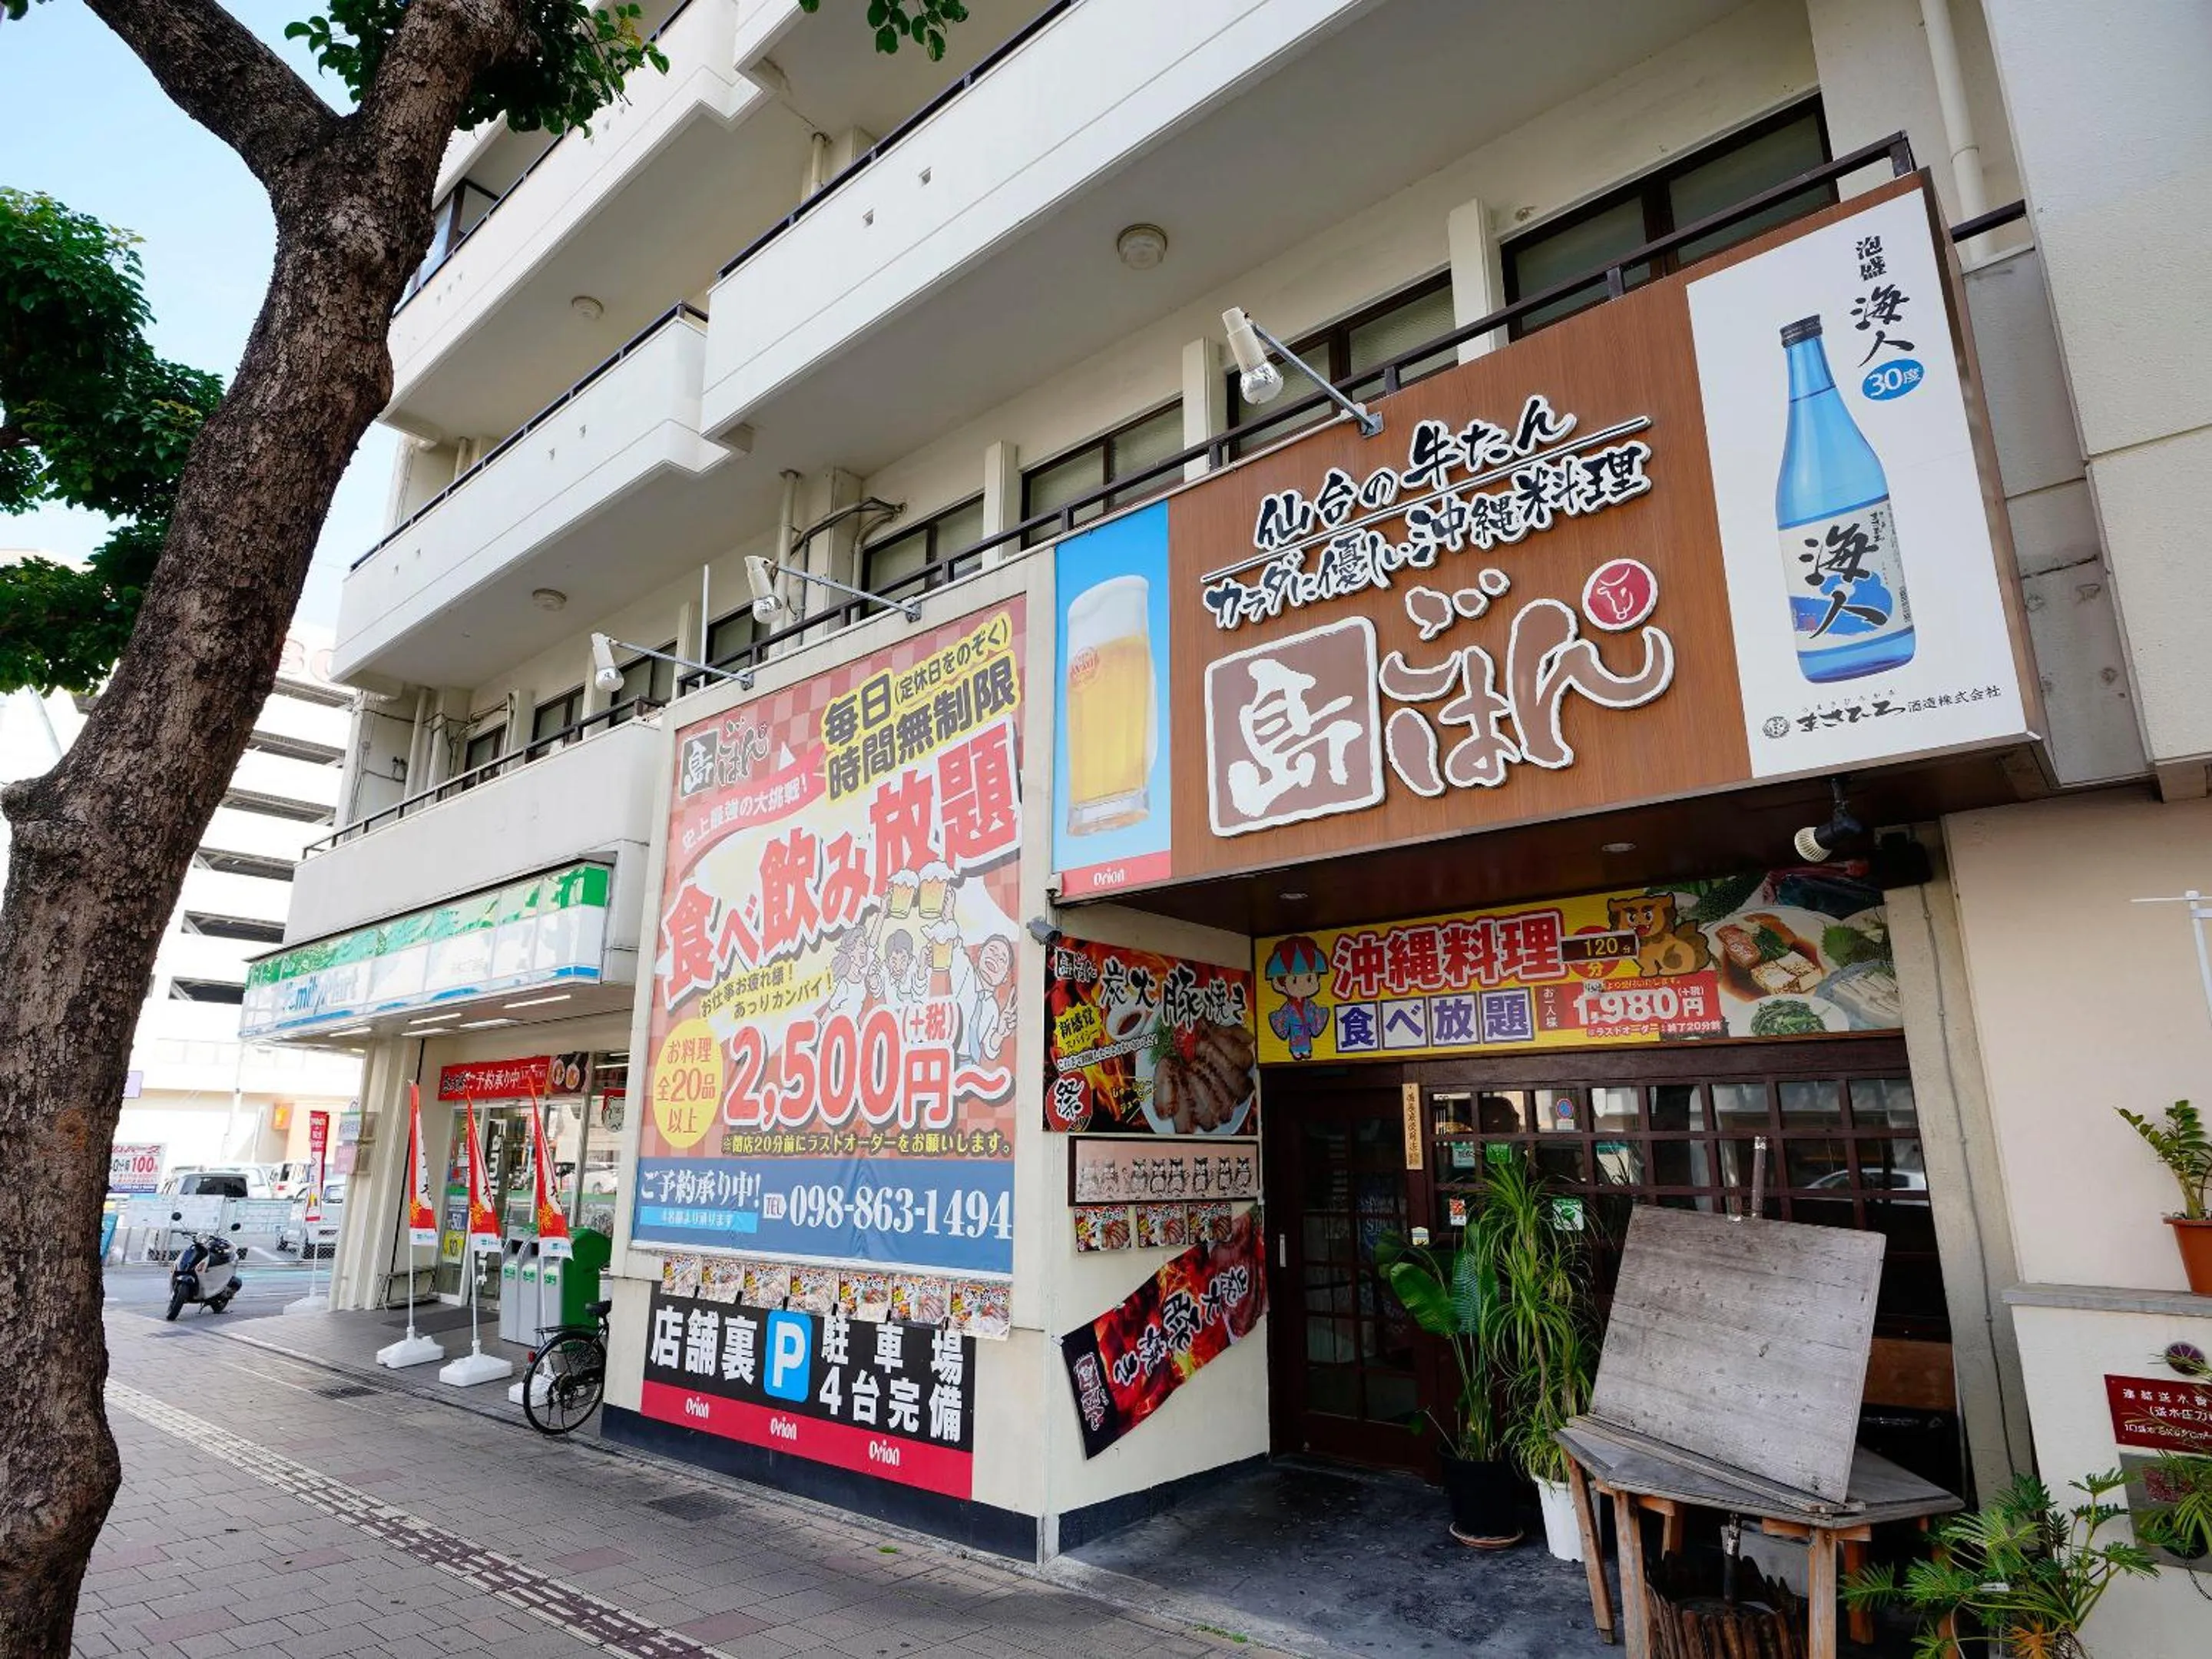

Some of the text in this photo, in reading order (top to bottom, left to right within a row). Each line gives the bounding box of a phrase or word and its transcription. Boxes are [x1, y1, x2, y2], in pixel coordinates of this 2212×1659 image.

[1849, 283, 1916, 369] 海人
[1867, 367, 1922, 396] 30度
[1255, 396, 1576, 550] 仙台の牛たん
[1204, 442, 1651, 629] カラダに優しい沖縄料理
[1798, 522, 1889, 639] 海人
[824, 673, 892, 747] 毎日
[894, 617, 1008, 704] (定休日をのぞく)
[828, 655, 1016, 800] 時間無制限
[667, 722, 1018, 992] 食べ飲み放題
[1092, 866, 1126, 887] Orion
[1333, 908, 1565, 998] 沖縄料理
[701, 963, 793, 1018] お仕事お疲れ様!
[1542, 988, 1558, 1028] お一人様
[1573, 987, 1705, 1025] 1,980円
[1339, 994, 1530, 1049] 食べ放題
[667, 1038, 712, 1064] お料理
[657, 1068, 716, 1102] 全20品
[667, 1107, 697, 1134] 以上
[641, 1168, 762, 1209] ご予約承り中!
[790, 1184, 1012, 1240] 098-863-1494
[650, 1305, 758, 1385] 店舗裏
[773, 1321, 806, 1389] P
[821, 1313, 964, 1386] 駐車場
[685, 1396, 710, 1420] Orion
[770, 1416, 797, 1441] Orion
[819, 1365, 962, 1443] 4台完備
[869, 1439, 901, 1467] Orion
